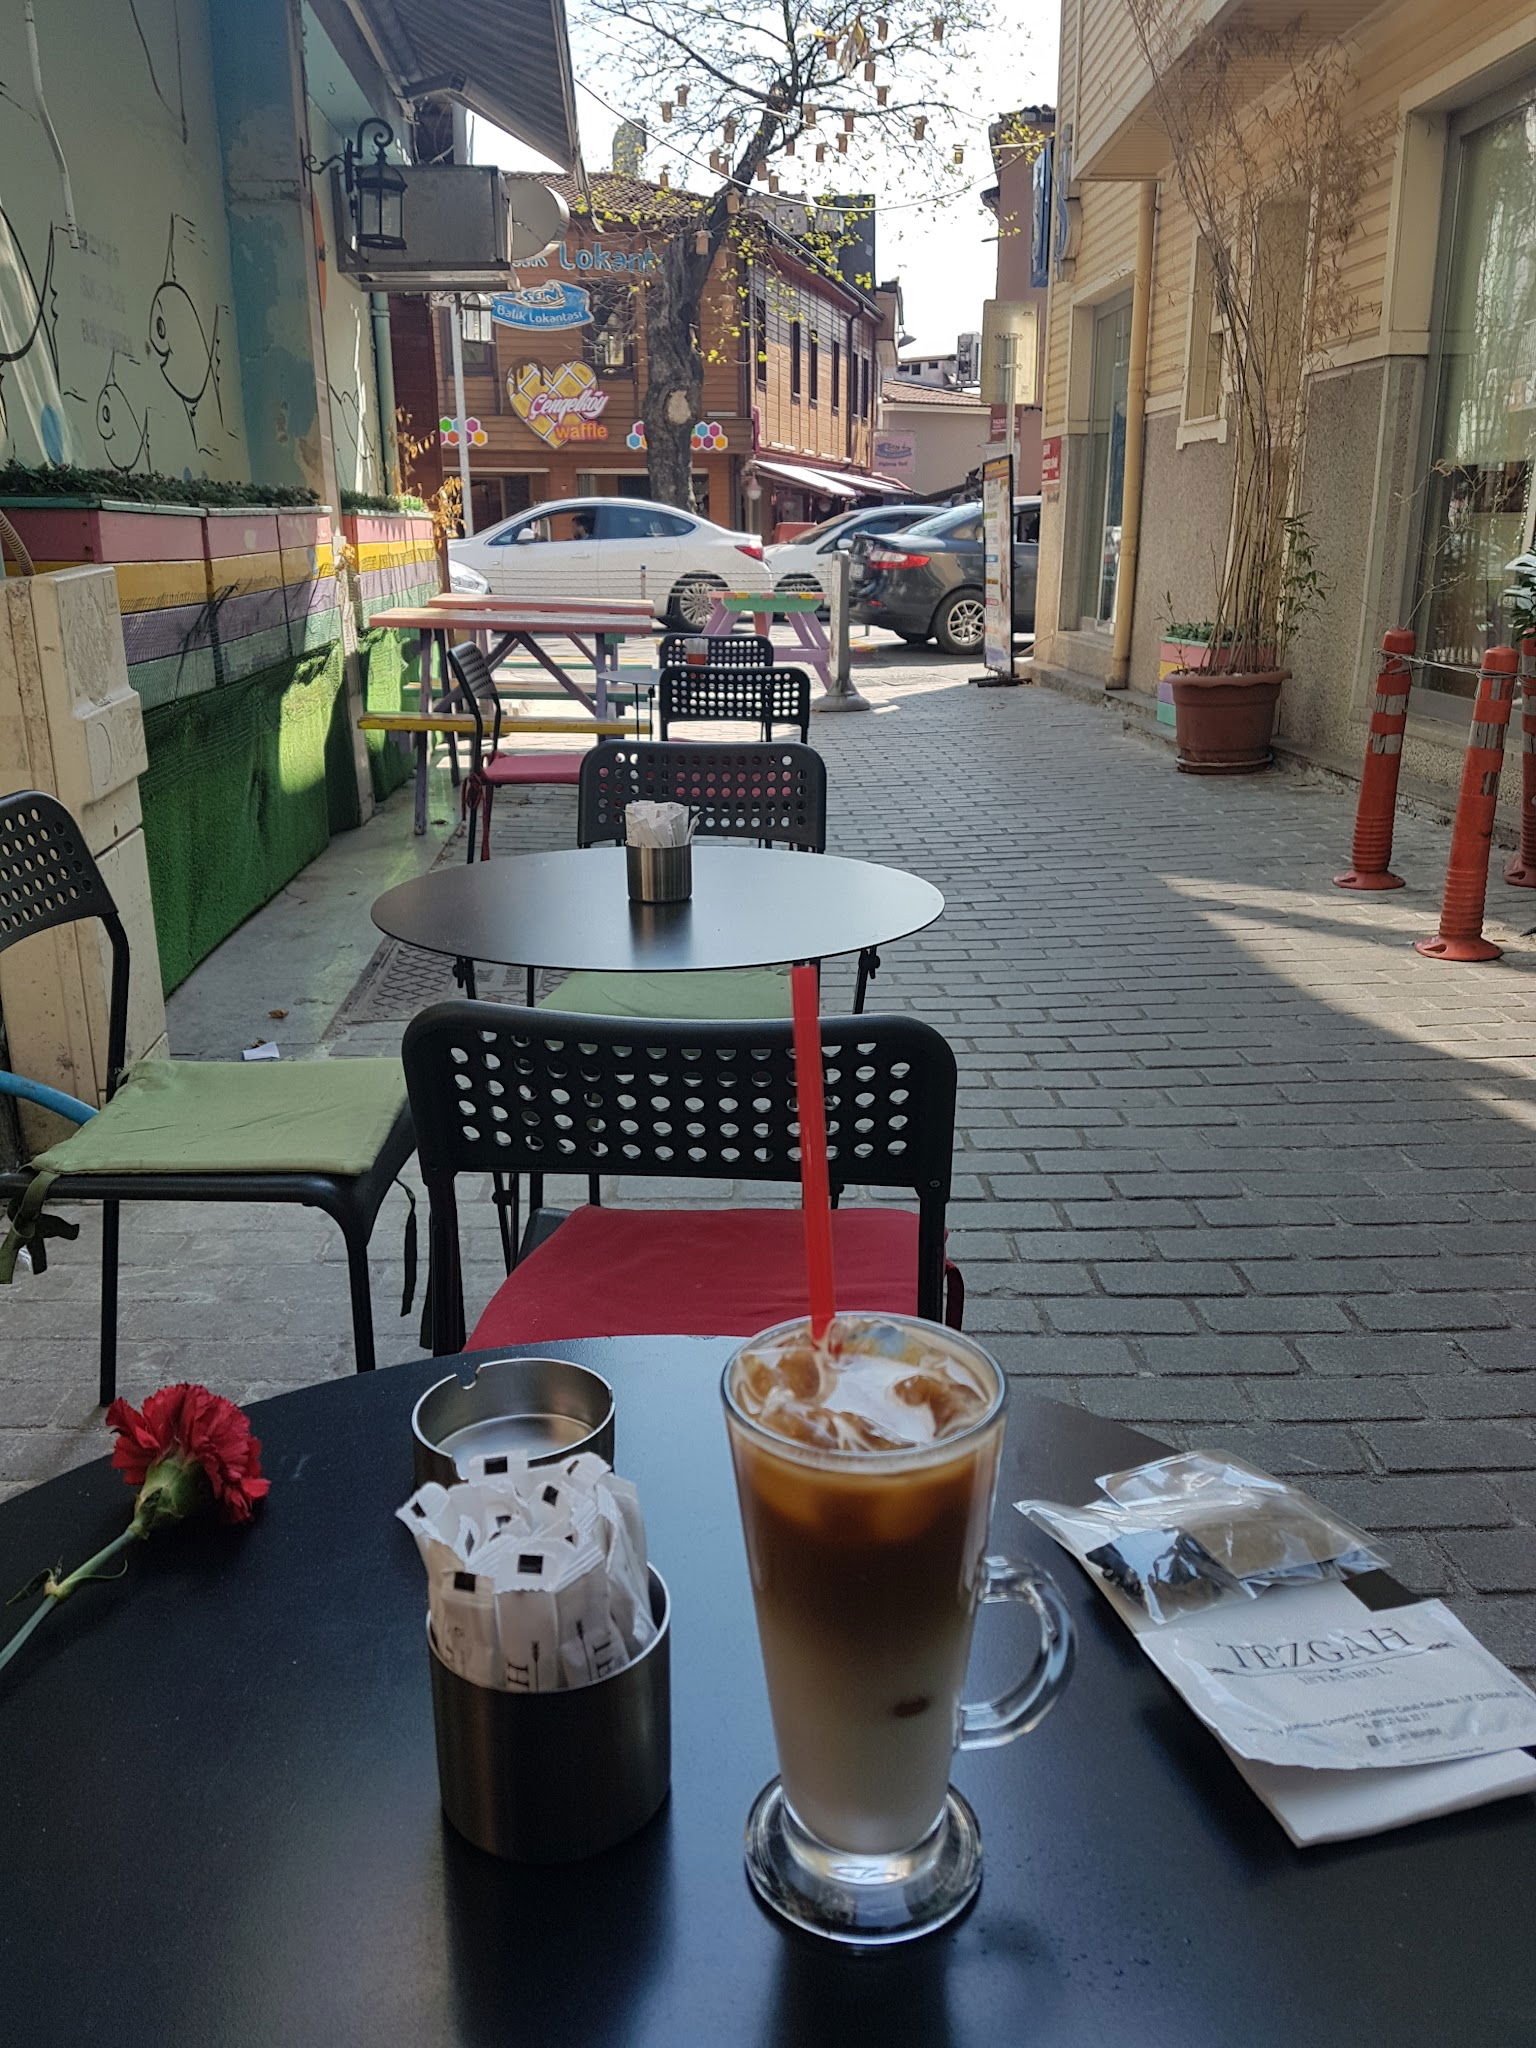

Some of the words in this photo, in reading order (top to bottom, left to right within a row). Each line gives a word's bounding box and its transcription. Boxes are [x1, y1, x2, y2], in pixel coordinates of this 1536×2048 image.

[529, 311, 584, 323] Lokantası
[555, 422, 608, 440] waffle
[1216, 1627, 1414, 1669] TEZGAH
